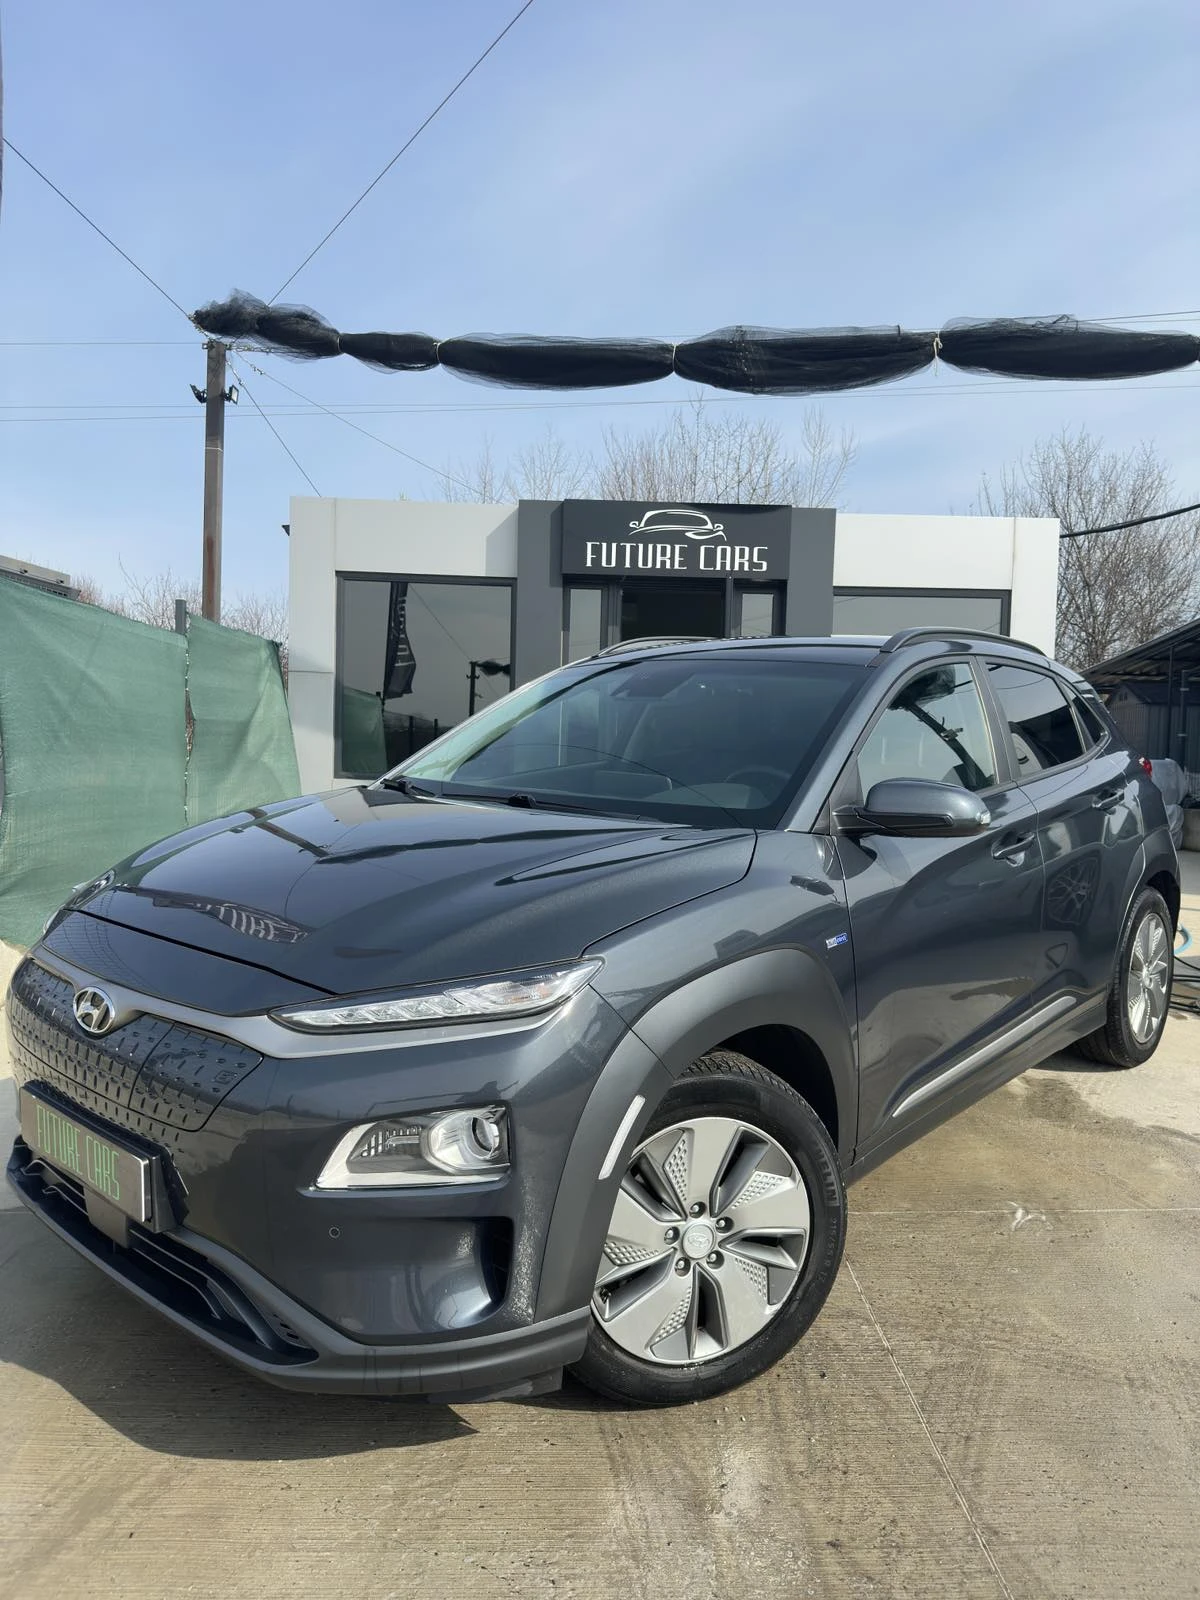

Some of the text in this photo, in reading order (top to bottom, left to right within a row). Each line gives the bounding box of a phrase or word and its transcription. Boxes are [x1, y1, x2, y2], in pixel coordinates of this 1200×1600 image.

[585, 541, 769, 572] FUTURE CARS
[36, 1104, 120, 1201] FUTURE CARS
